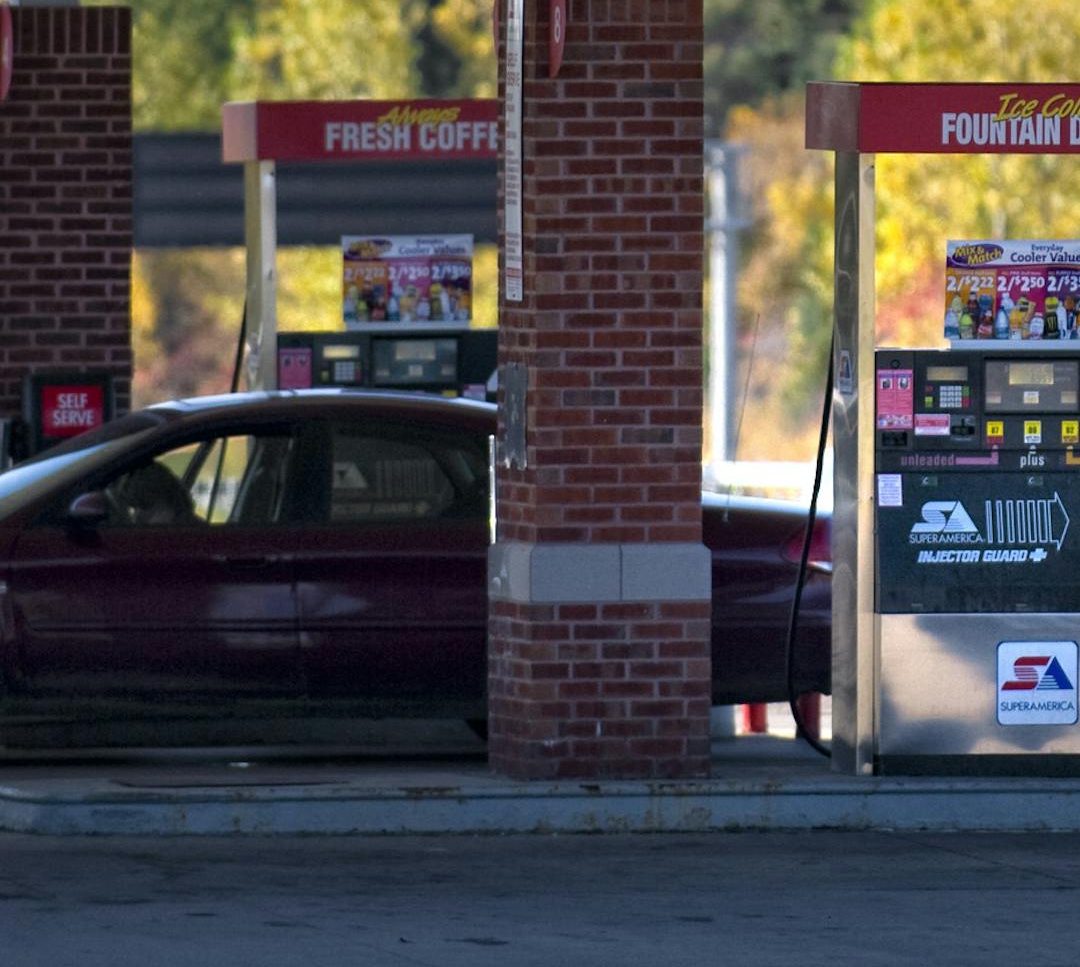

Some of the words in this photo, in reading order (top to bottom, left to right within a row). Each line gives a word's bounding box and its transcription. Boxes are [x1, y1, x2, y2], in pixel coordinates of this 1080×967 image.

[993, 92, 1038, 122] Ice
[325, 121, 412, 151] FRESH
[941, 113, 1061, 145] FOUNTAIN
[1031, 244, 1064, 253] Everyday
[968, 248, 1002, 265] Match
[1010, 252, 1046, 263] Cooler
[57, 393, 88, 409] SELF
[52, 409, 94, 426] SERVE
[901, 453, 954, 466] unleaded
[1020, 453, 1045, 468] plus
[909, 533, 983, 544] SUPERAMERICA
[917, 549, 979, 563] INJECTOR
[982, 549, 1028, 562] GUARD
[1000, 700, 1075, 712] SUPERAMERICA
